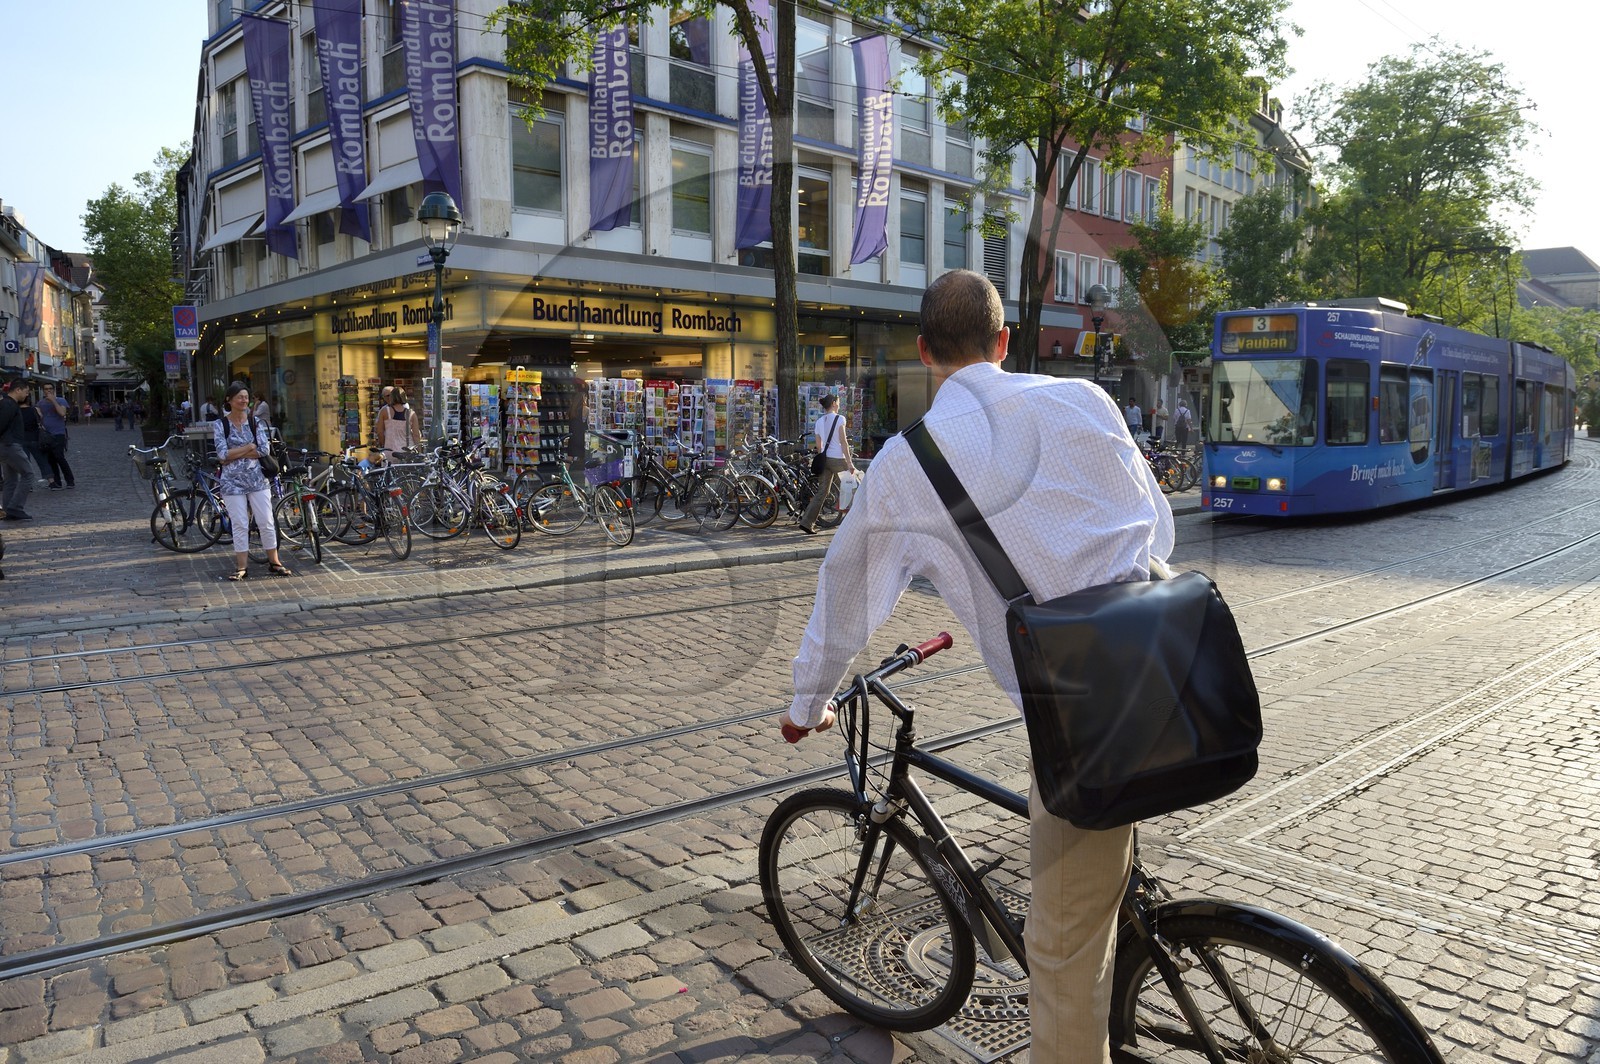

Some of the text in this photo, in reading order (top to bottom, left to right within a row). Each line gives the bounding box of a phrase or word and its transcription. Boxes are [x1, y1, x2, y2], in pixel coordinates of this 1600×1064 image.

[331, 42, 363, 175] Rombach
[867, 93, 893, 206] Rombach
[331, 308, 397, 334] Buchhandlung
[533, 298, 741, 333] Buchhandlung Rombach
[1257, 317, 1266, 330] 3
[1327, 312, 1340, 322] 257
[177, 328, 197, 336] TAXI
[1238, 337, 1287, 350] Vauban
[1350, 464, 1378, 486] Bringt
[1213, 498, 1234, 508] 257
